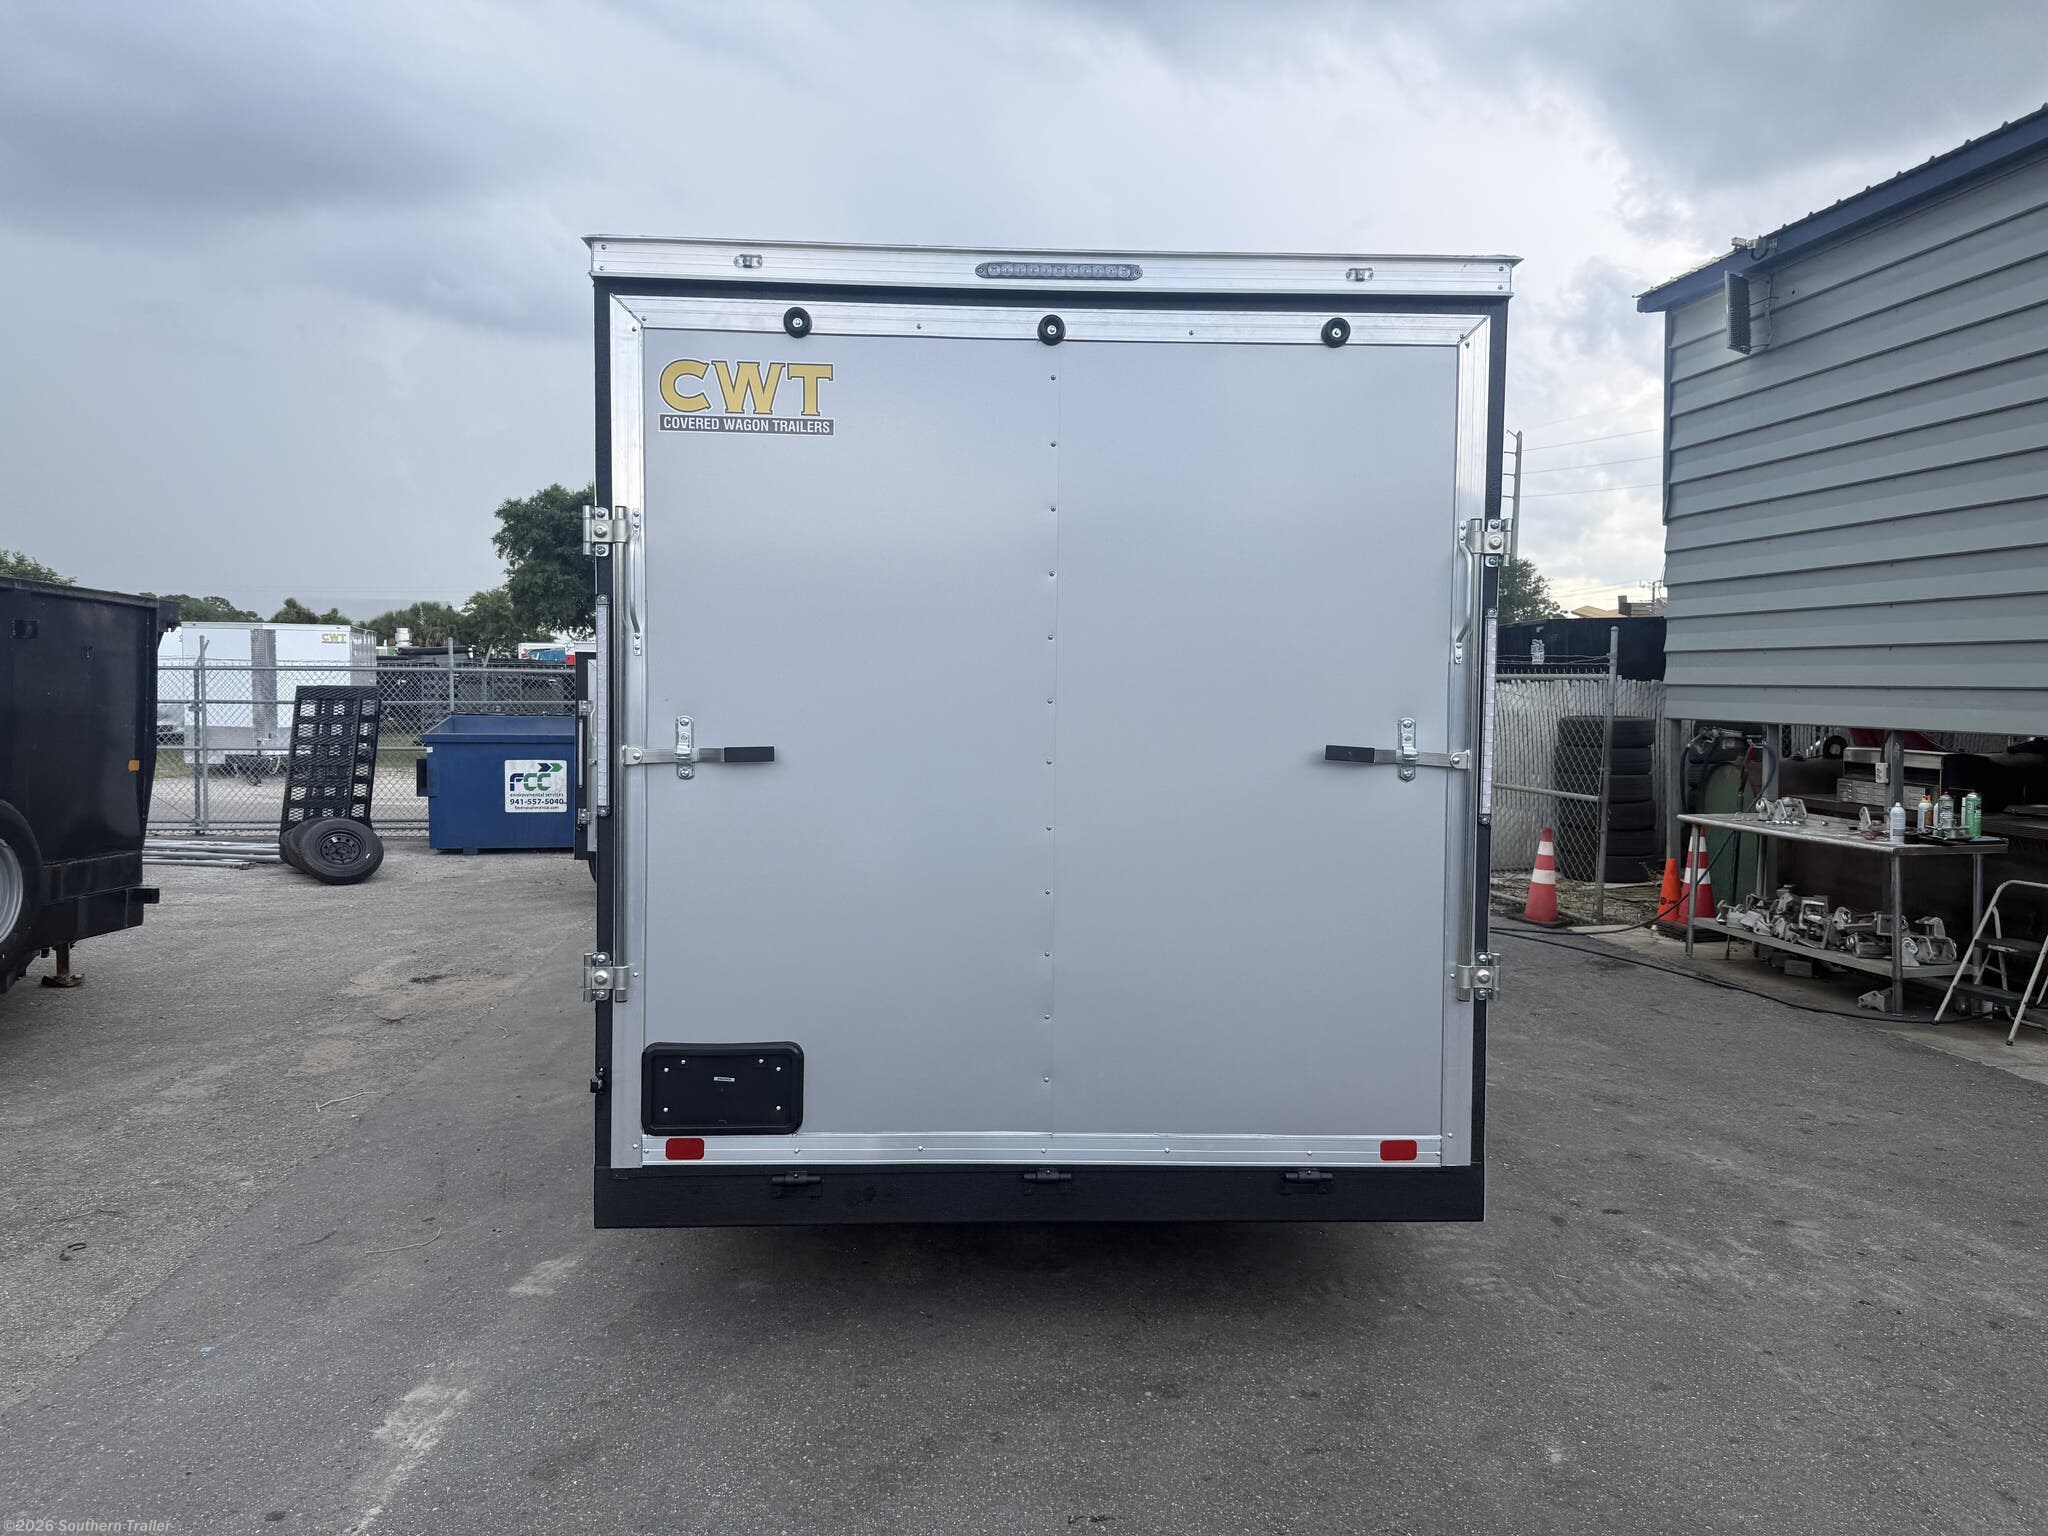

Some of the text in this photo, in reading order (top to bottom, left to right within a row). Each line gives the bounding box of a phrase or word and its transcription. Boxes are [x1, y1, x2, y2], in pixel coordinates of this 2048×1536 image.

[659, 359, 833, 416] CWT
[663, 416, 831, 433] COVERED WAGON TRAILERS
[322, 633, 346, 641] CWT
[510, 773, 551, 791] FCC
